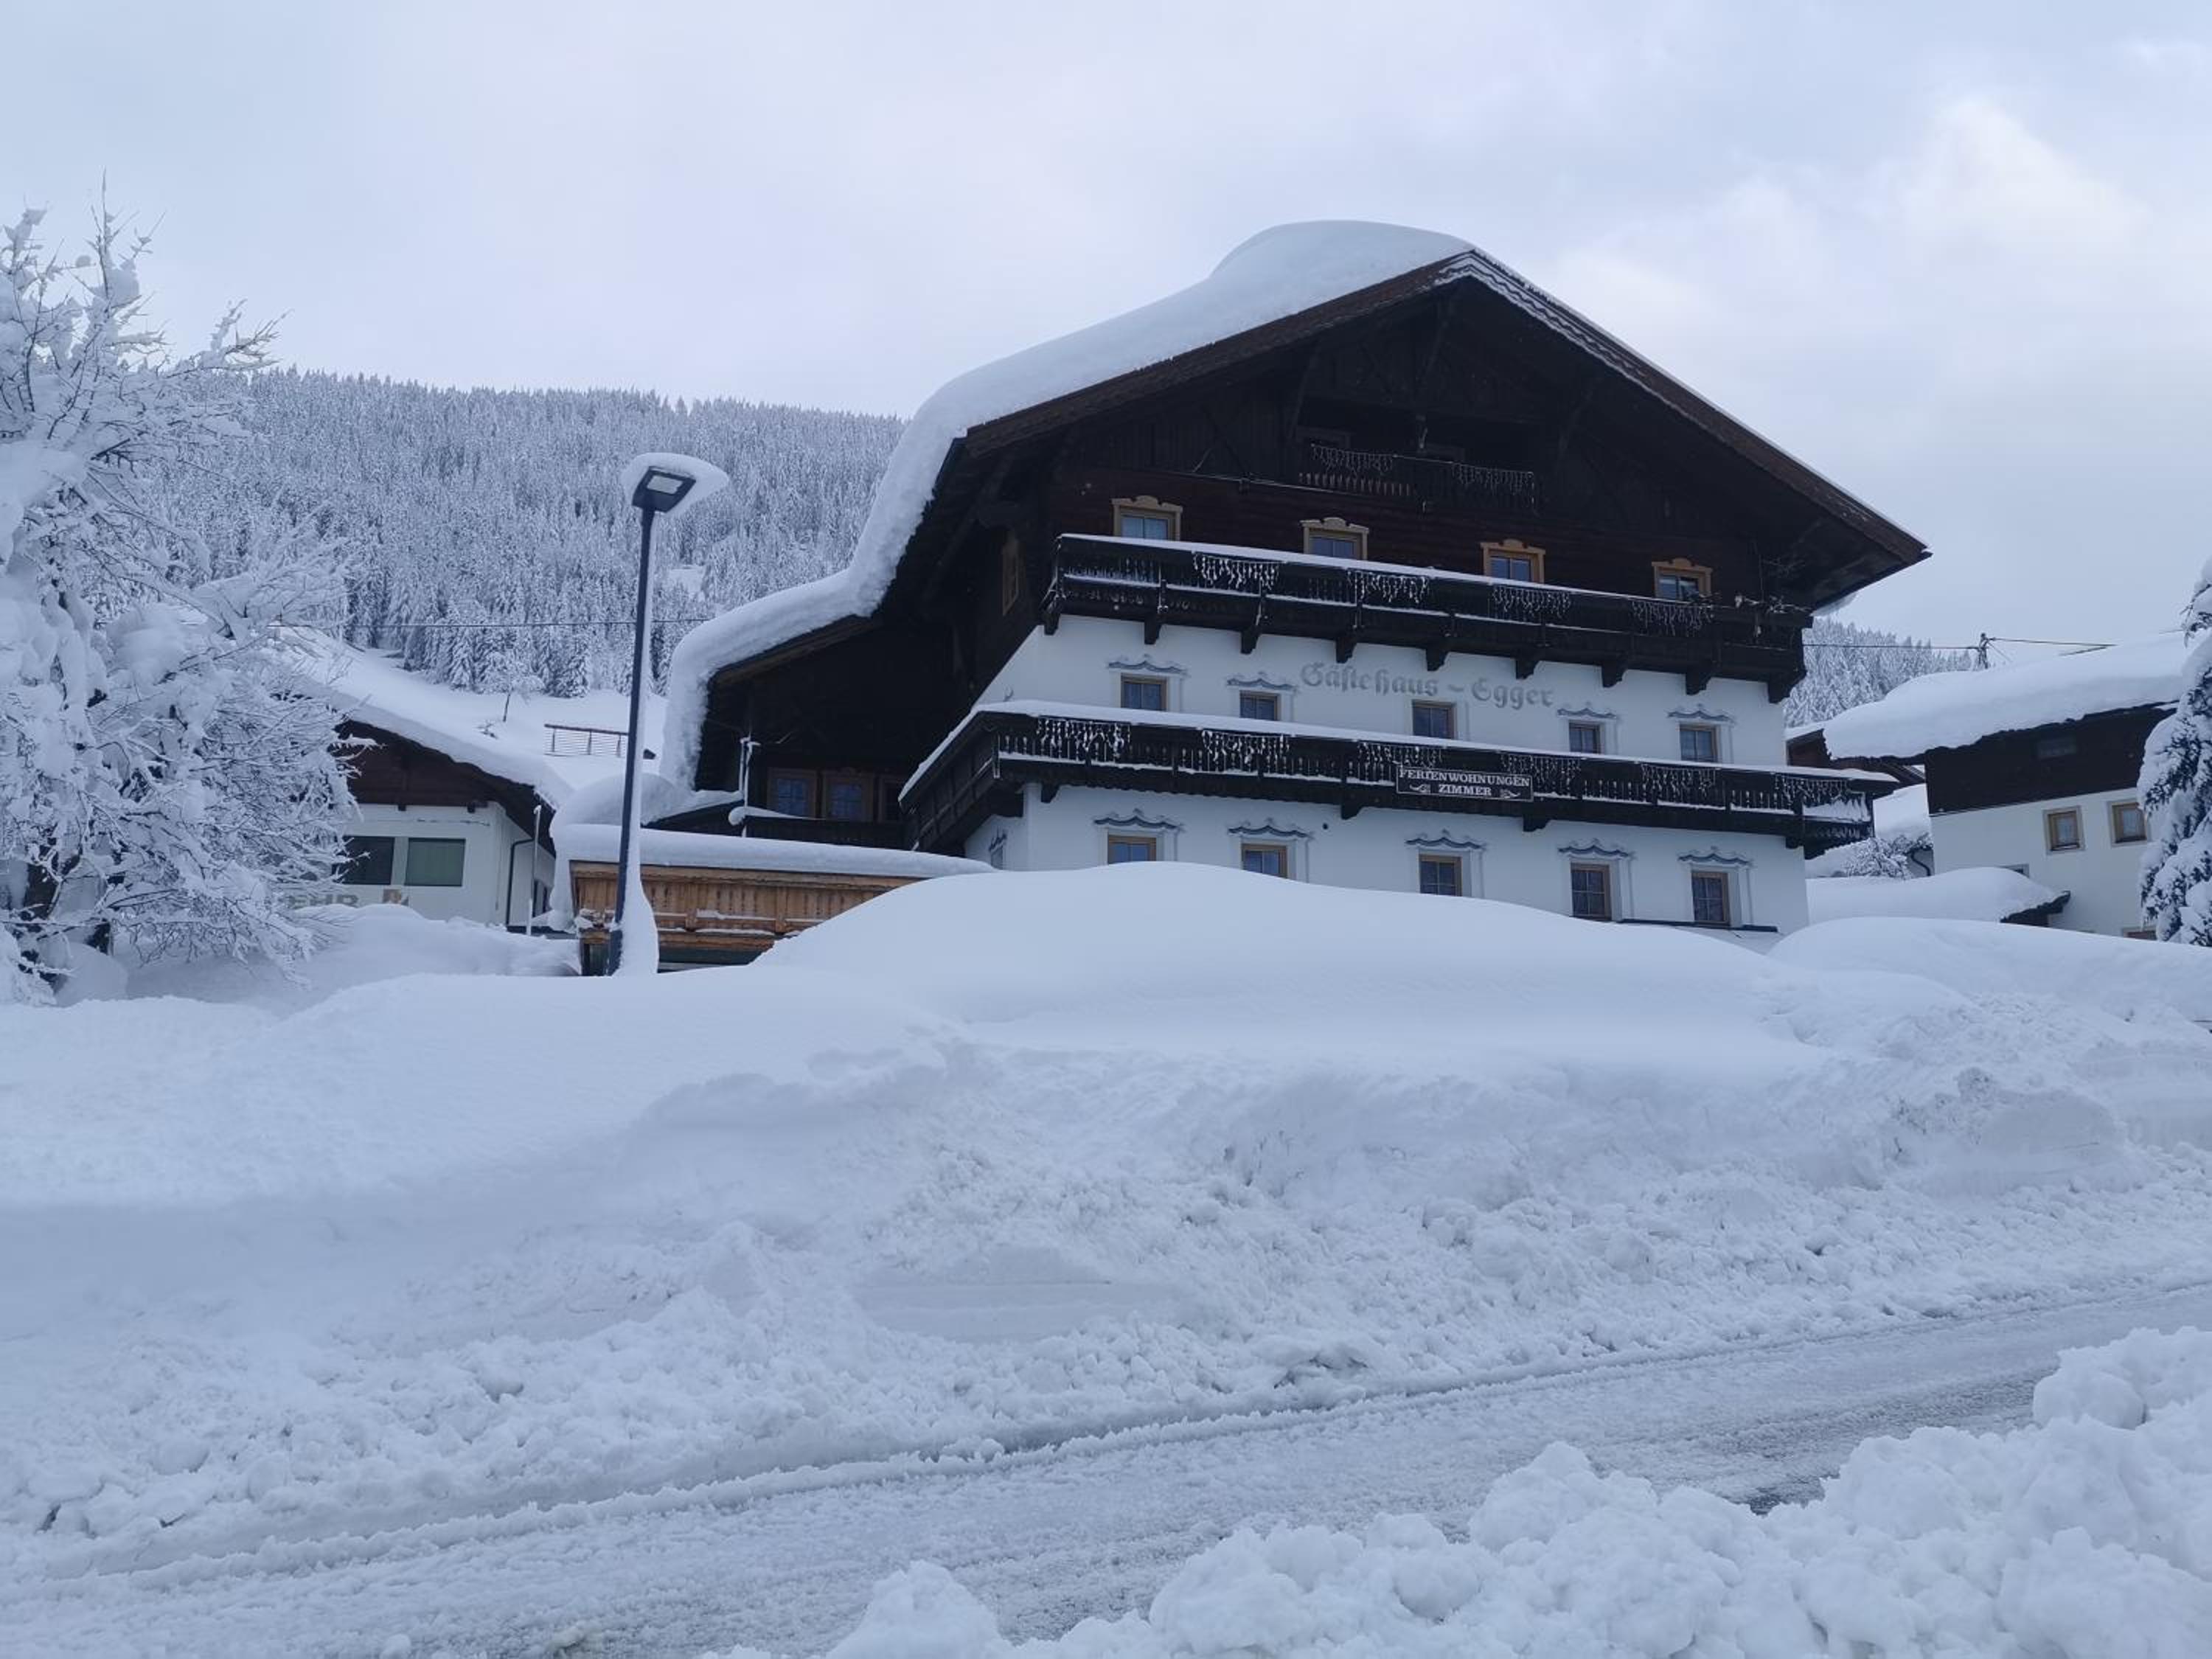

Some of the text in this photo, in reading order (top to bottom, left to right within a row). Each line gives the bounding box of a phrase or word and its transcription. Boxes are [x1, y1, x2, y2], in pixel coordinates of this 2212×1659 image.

[1472, 678, 1554, 710] Egger
[1399, 768, 1531, 787] FERIENWOHNUNGEN
[1439, 783, 1492, 796] ZIMMER
